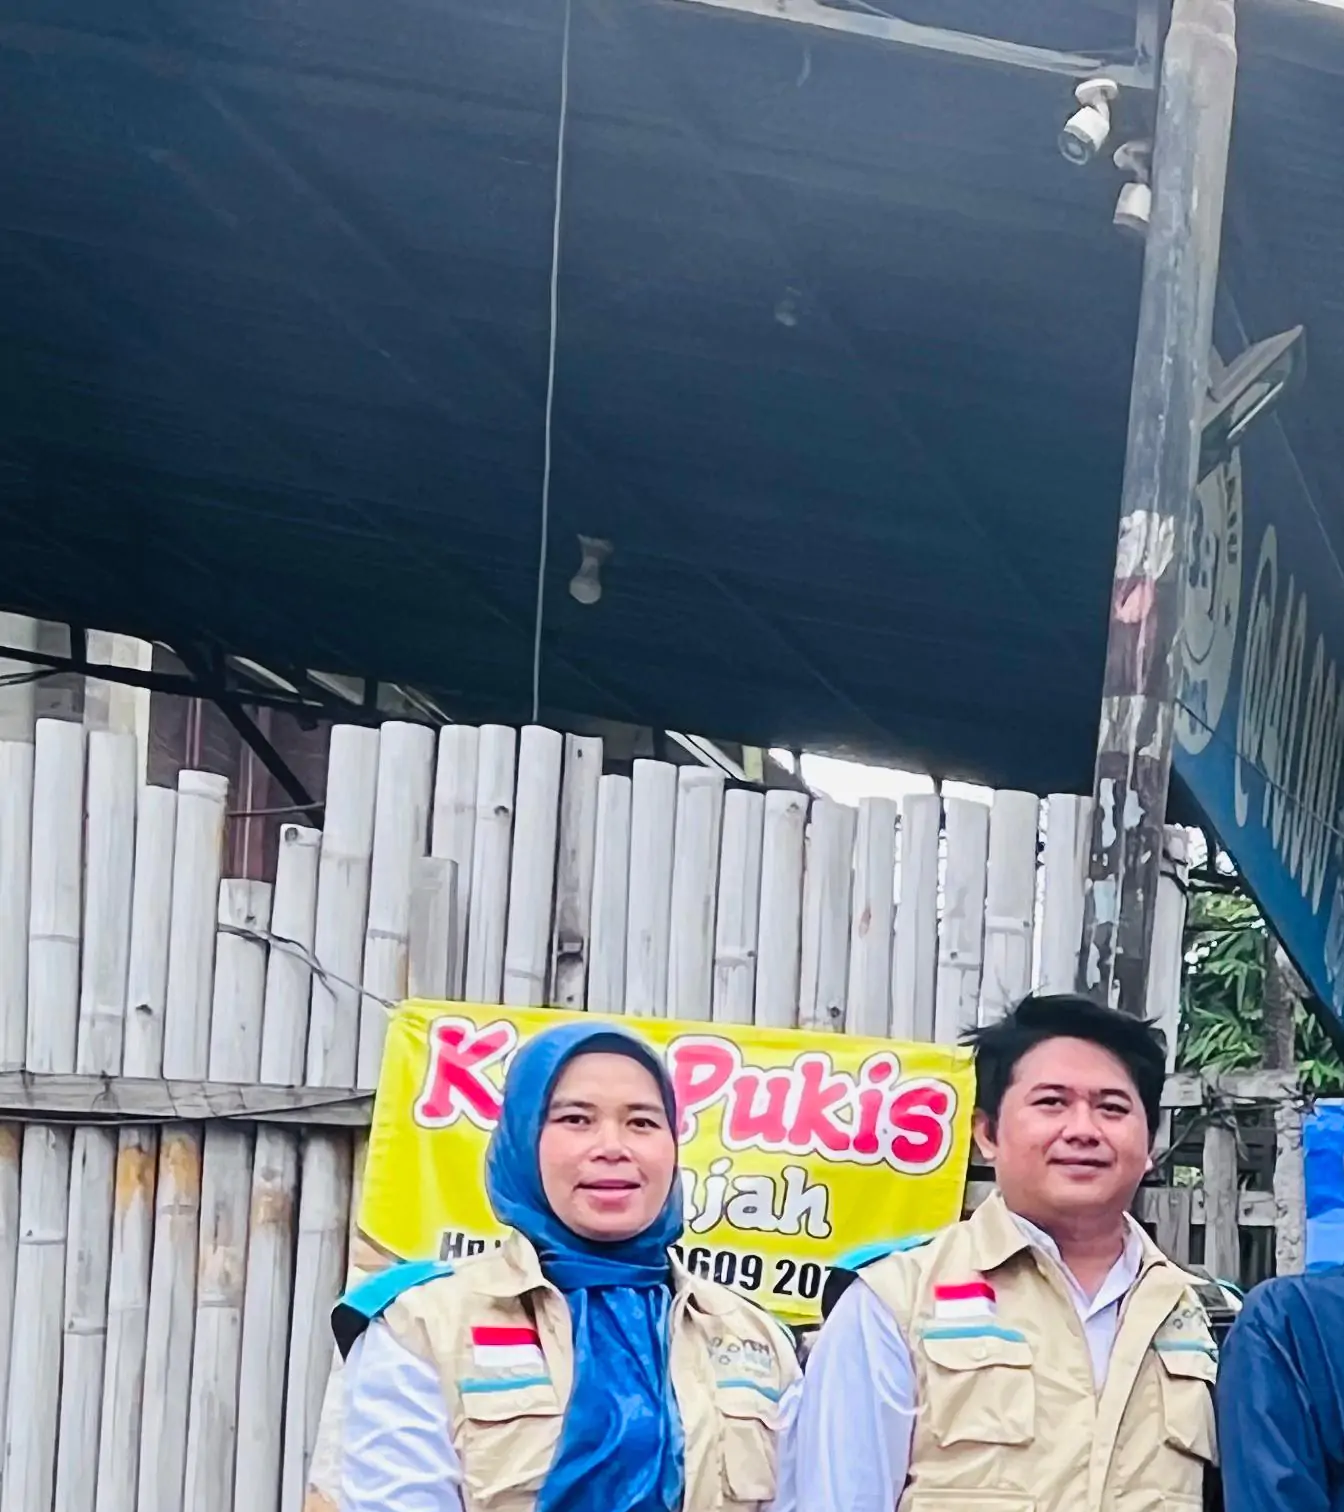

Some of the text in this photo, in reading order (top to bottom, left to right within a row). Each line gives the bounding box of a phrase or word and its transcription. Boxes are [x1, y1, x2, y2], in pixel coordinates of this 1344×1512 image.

[671, 1037, 952, 1170] Pukis
[671, 1245, 830, 1298] 609 20
